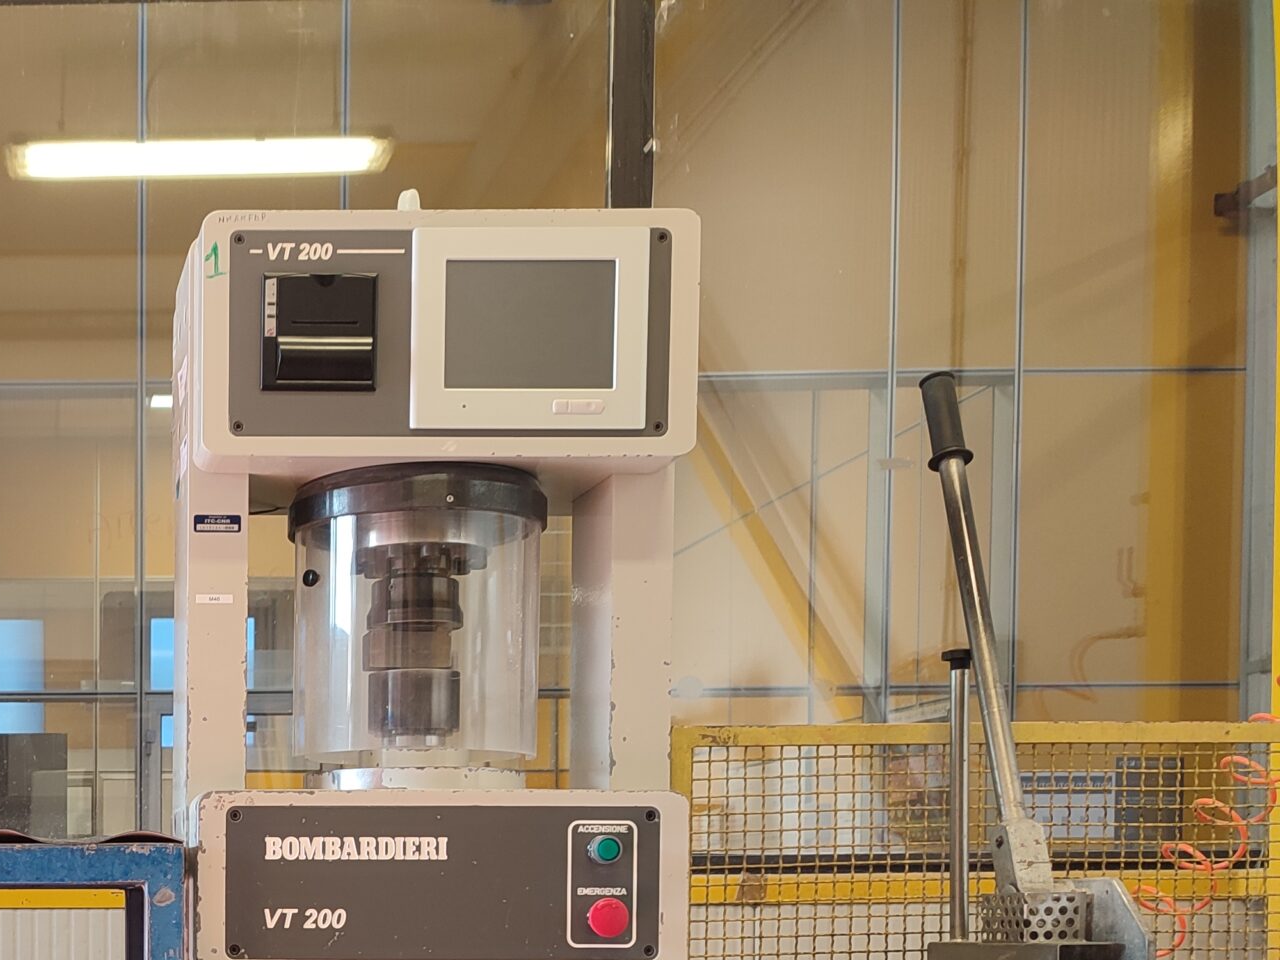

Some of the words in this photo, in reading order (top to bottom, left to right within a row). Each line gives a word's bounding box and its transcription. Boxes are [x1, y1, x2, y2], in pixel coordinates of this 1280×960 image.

[204, 241, 227, 279] 1
[267, 242, 296, 261] VT
[297, 242, 333, 261] 200
[577, 825, 629, 833] ACCENSIONE
[264, 836, 448, 861] BOMBARDIERI
[577, 887, 627, 896] EMERGENZA
[263, 908, 298, 929] VT
[303, 908, 347, 929] 200
